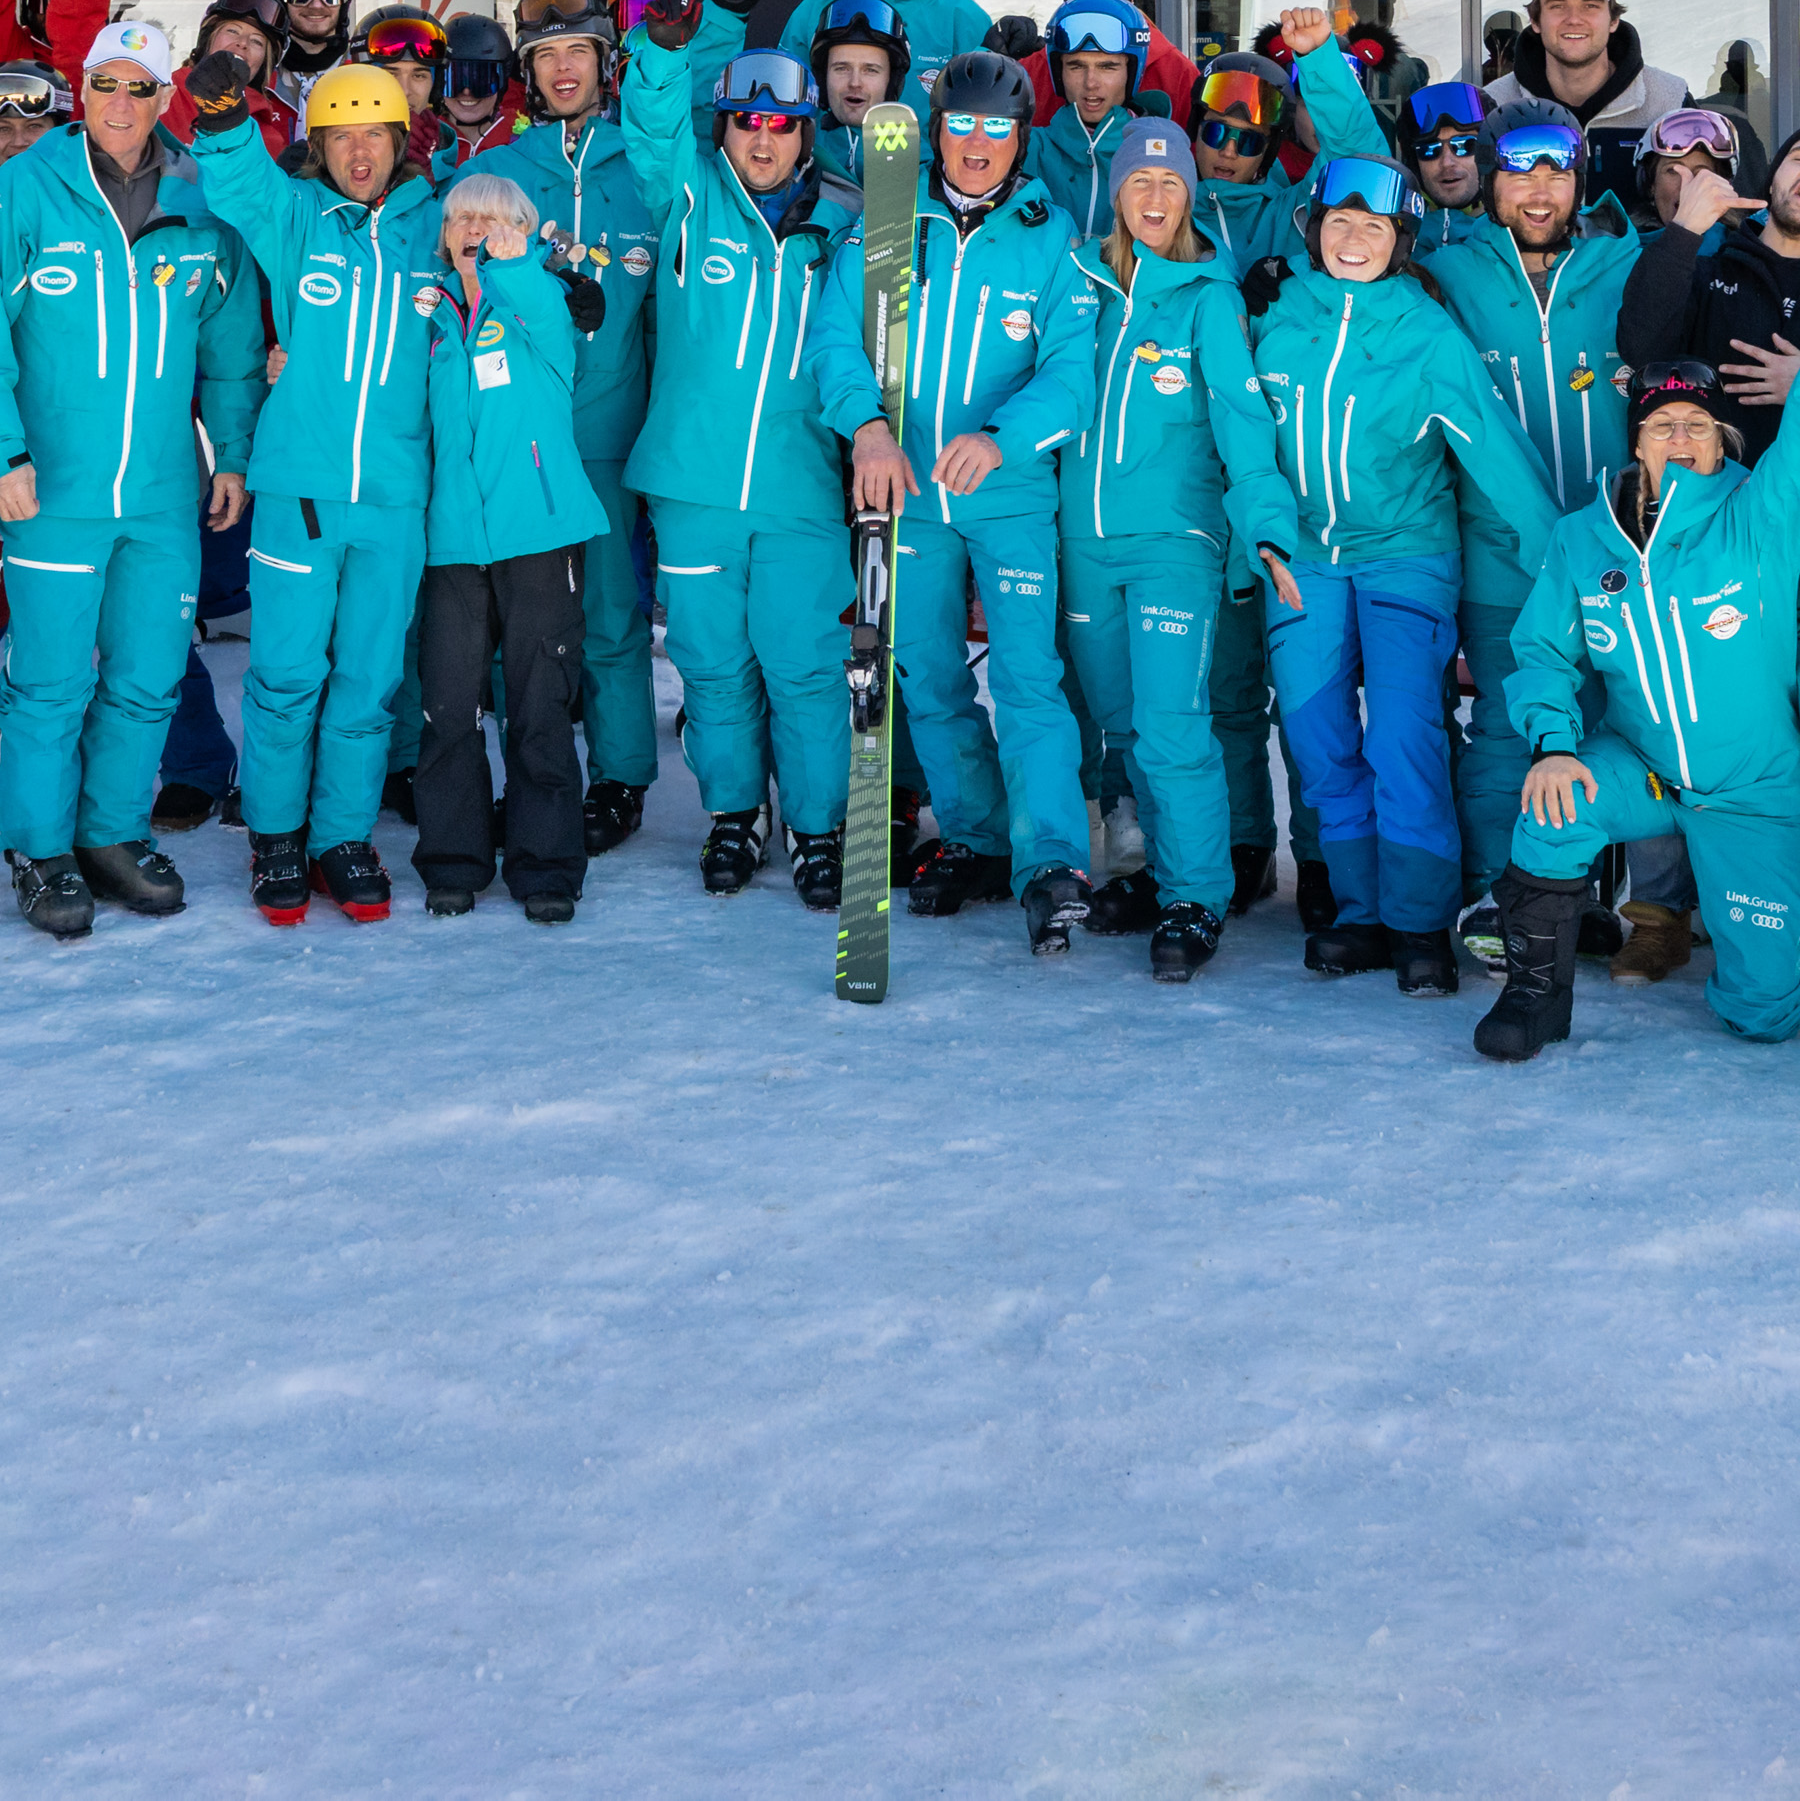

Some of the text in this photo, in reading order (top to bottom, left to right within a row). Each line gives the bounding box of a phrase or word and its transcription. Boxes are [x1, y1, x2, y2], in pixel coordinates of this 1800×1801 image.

[619, 232, 642, 240] EUROPA
[866, 247, 893, 263] Völkl
[410, 271, 434, 280] EUROPA
[706, 264, 728, 276] Thoma
[39, 275, 69, 285] Thoma
[307, 282, 334, 295] Thoma
[876, 290, 887, 389] PEREGRINE
[1693, 582, 1743, 606] EUROPA PARK
[1141, 605, 1194, 620] Link.Gruppe
[1726, 890, 1788, 914] Link.Gruppe
[847, 982, 876, 990] Völkl
